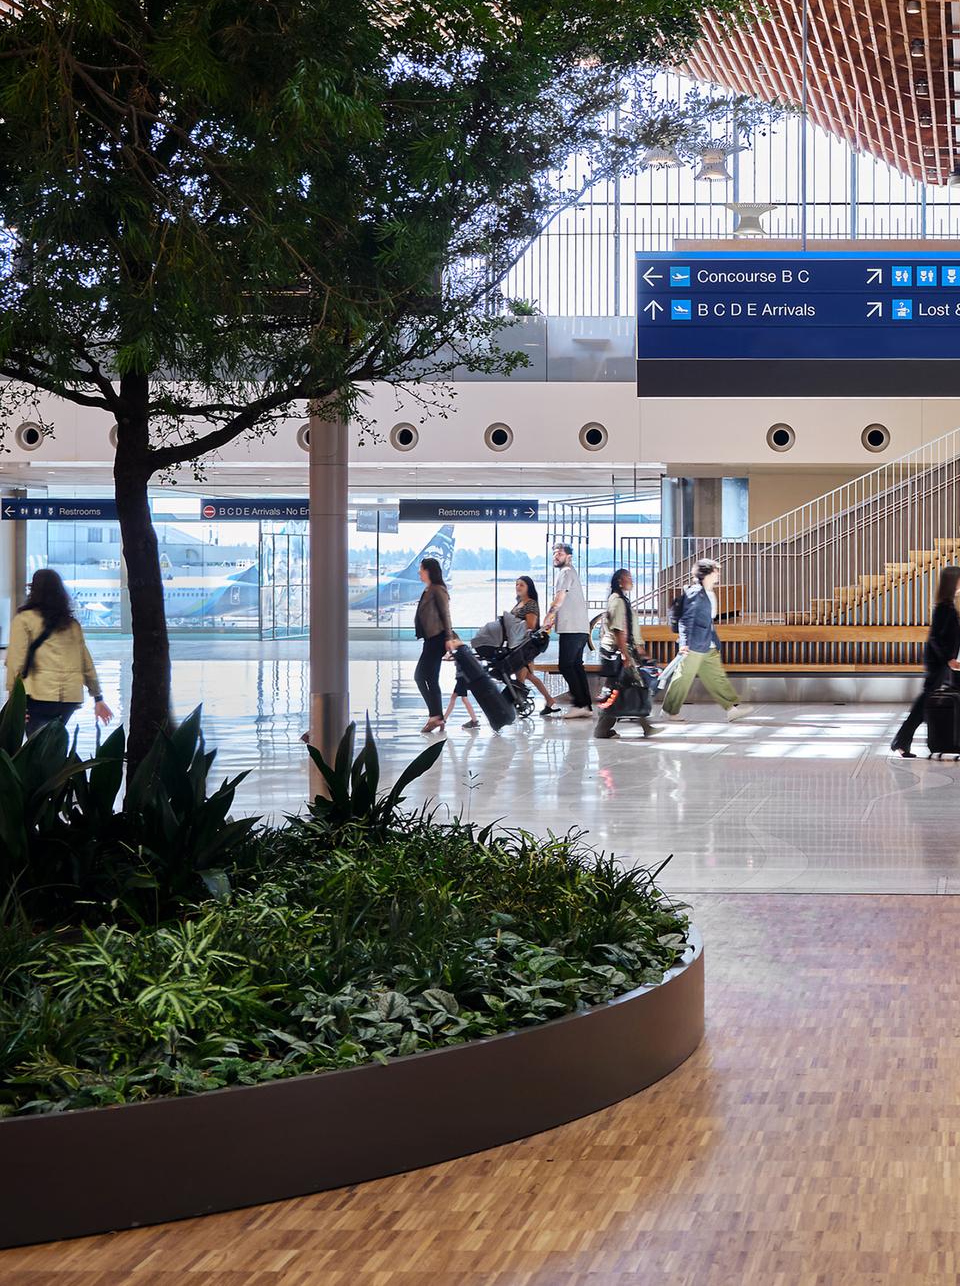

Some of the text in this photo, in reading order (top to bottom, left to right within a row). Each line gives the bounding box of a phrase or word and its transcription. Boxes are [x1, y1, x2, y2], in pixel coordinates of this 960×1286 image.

[697, 269, 810, 284] Concourse B C
[697, 303, 816, 317] B C D E Arrivals
[918, 302, 950, 317] Lost
[59, 507, 101, 516] Restrooms
[218, 507, 226, 516] B
[226, 507, 235, 516] C
[235, 507, 243, 516] D
[243, 507, 250, 516] E
[251, 507, 281, 516] Arrivals
[285, 507, 298, 516] No
[299, 507, 310, 516] En
[438, 508, 480, 517] Restrooms
